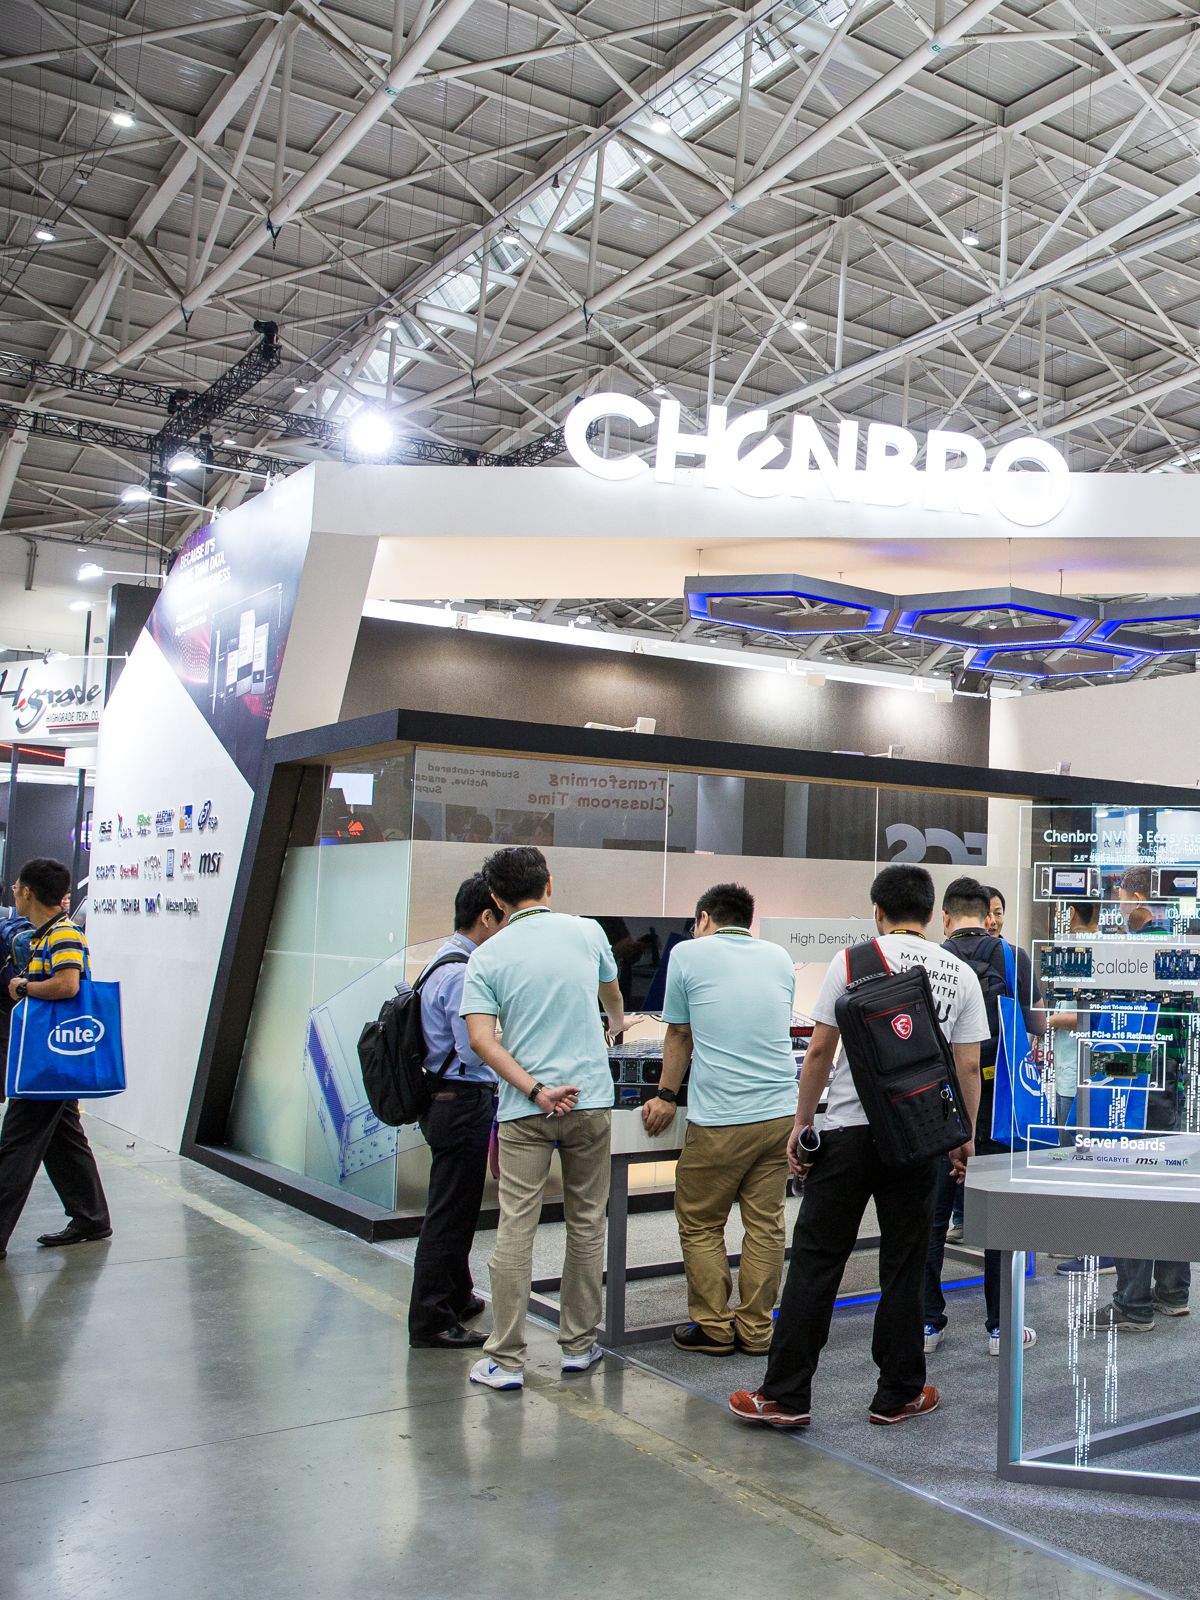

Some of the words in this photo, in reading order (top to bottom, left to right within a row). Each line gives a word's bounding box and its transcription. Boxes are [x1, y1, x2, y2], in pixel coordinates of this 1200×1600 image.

[565, 392, 1070, 527] CHENBRO
[1044, 829, 1099, 843] Chenbro
[199, 852, 222, 873] msi
[790, 932, 815, 946] High
[818, 932, 857, 946] Density
[900, 952, 928, 965] MAY
[940, 959, 960, 973] THE
[1069, 1030, 1090, 1039] 4-port
[1155, 1032, 1174, 1041] Card
[1075, 1134, 1117, 1149] Server
[1120, 1136, 1166, 1151] Boards
[1096, 1155, 1130, 1164] GIGABYTE
[1135, 1157, 1158, 1166] msi
